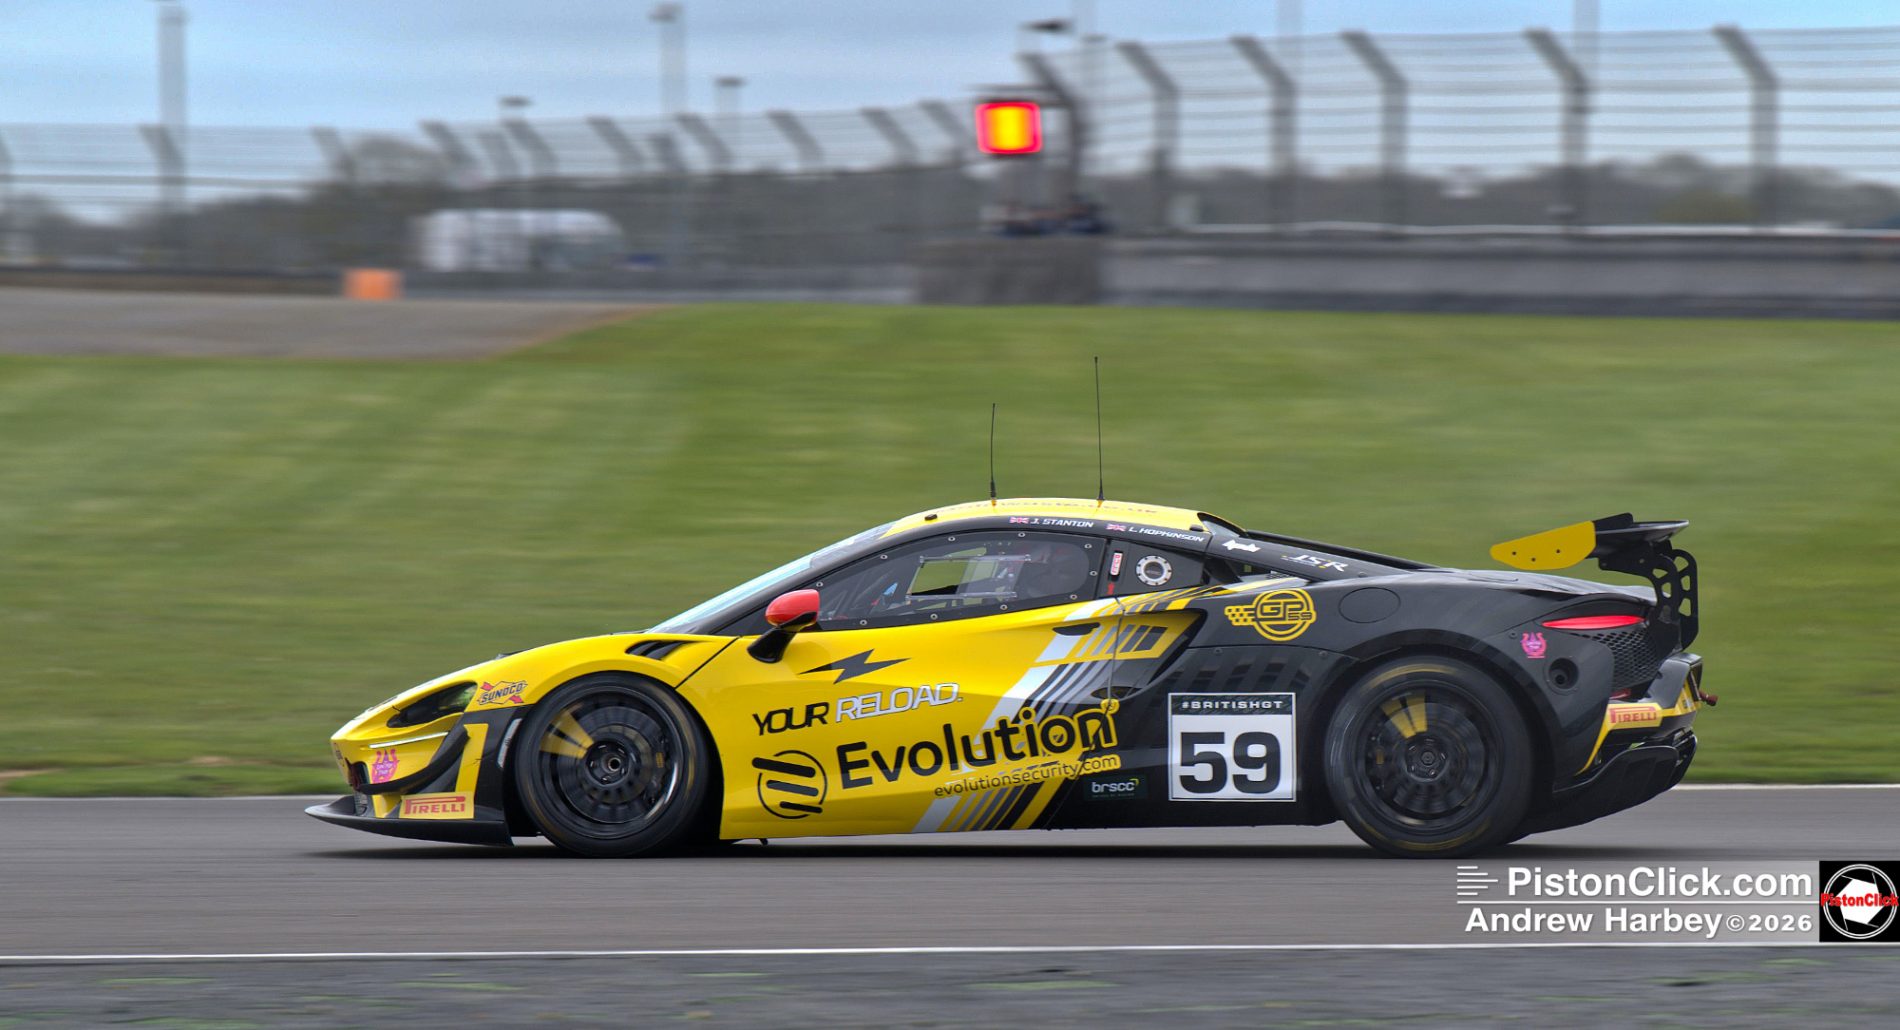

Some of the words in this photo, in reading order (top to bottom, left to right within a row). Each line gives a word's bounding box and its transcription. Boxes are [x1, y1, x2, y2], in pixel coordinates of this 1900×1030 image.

[1042, 518, 1094, 528] STANTON
[1139, 528, 1204, 543] HOPKINSON
[481, 682, 524, 702] SUNOCO
[1181, 700, 1284, 709] #BRITISHGT
[752, 702, 829, 736] YOUR
[1609, 706, 1657, 724] PIRELLI
[1179, 731, 1281, 794] 59
[934, 756, 1118, 797] evolutionsecuritycom
[1091, 781, 1135, 793] brscc
[404, 796, 466, 815] PIRELLI
